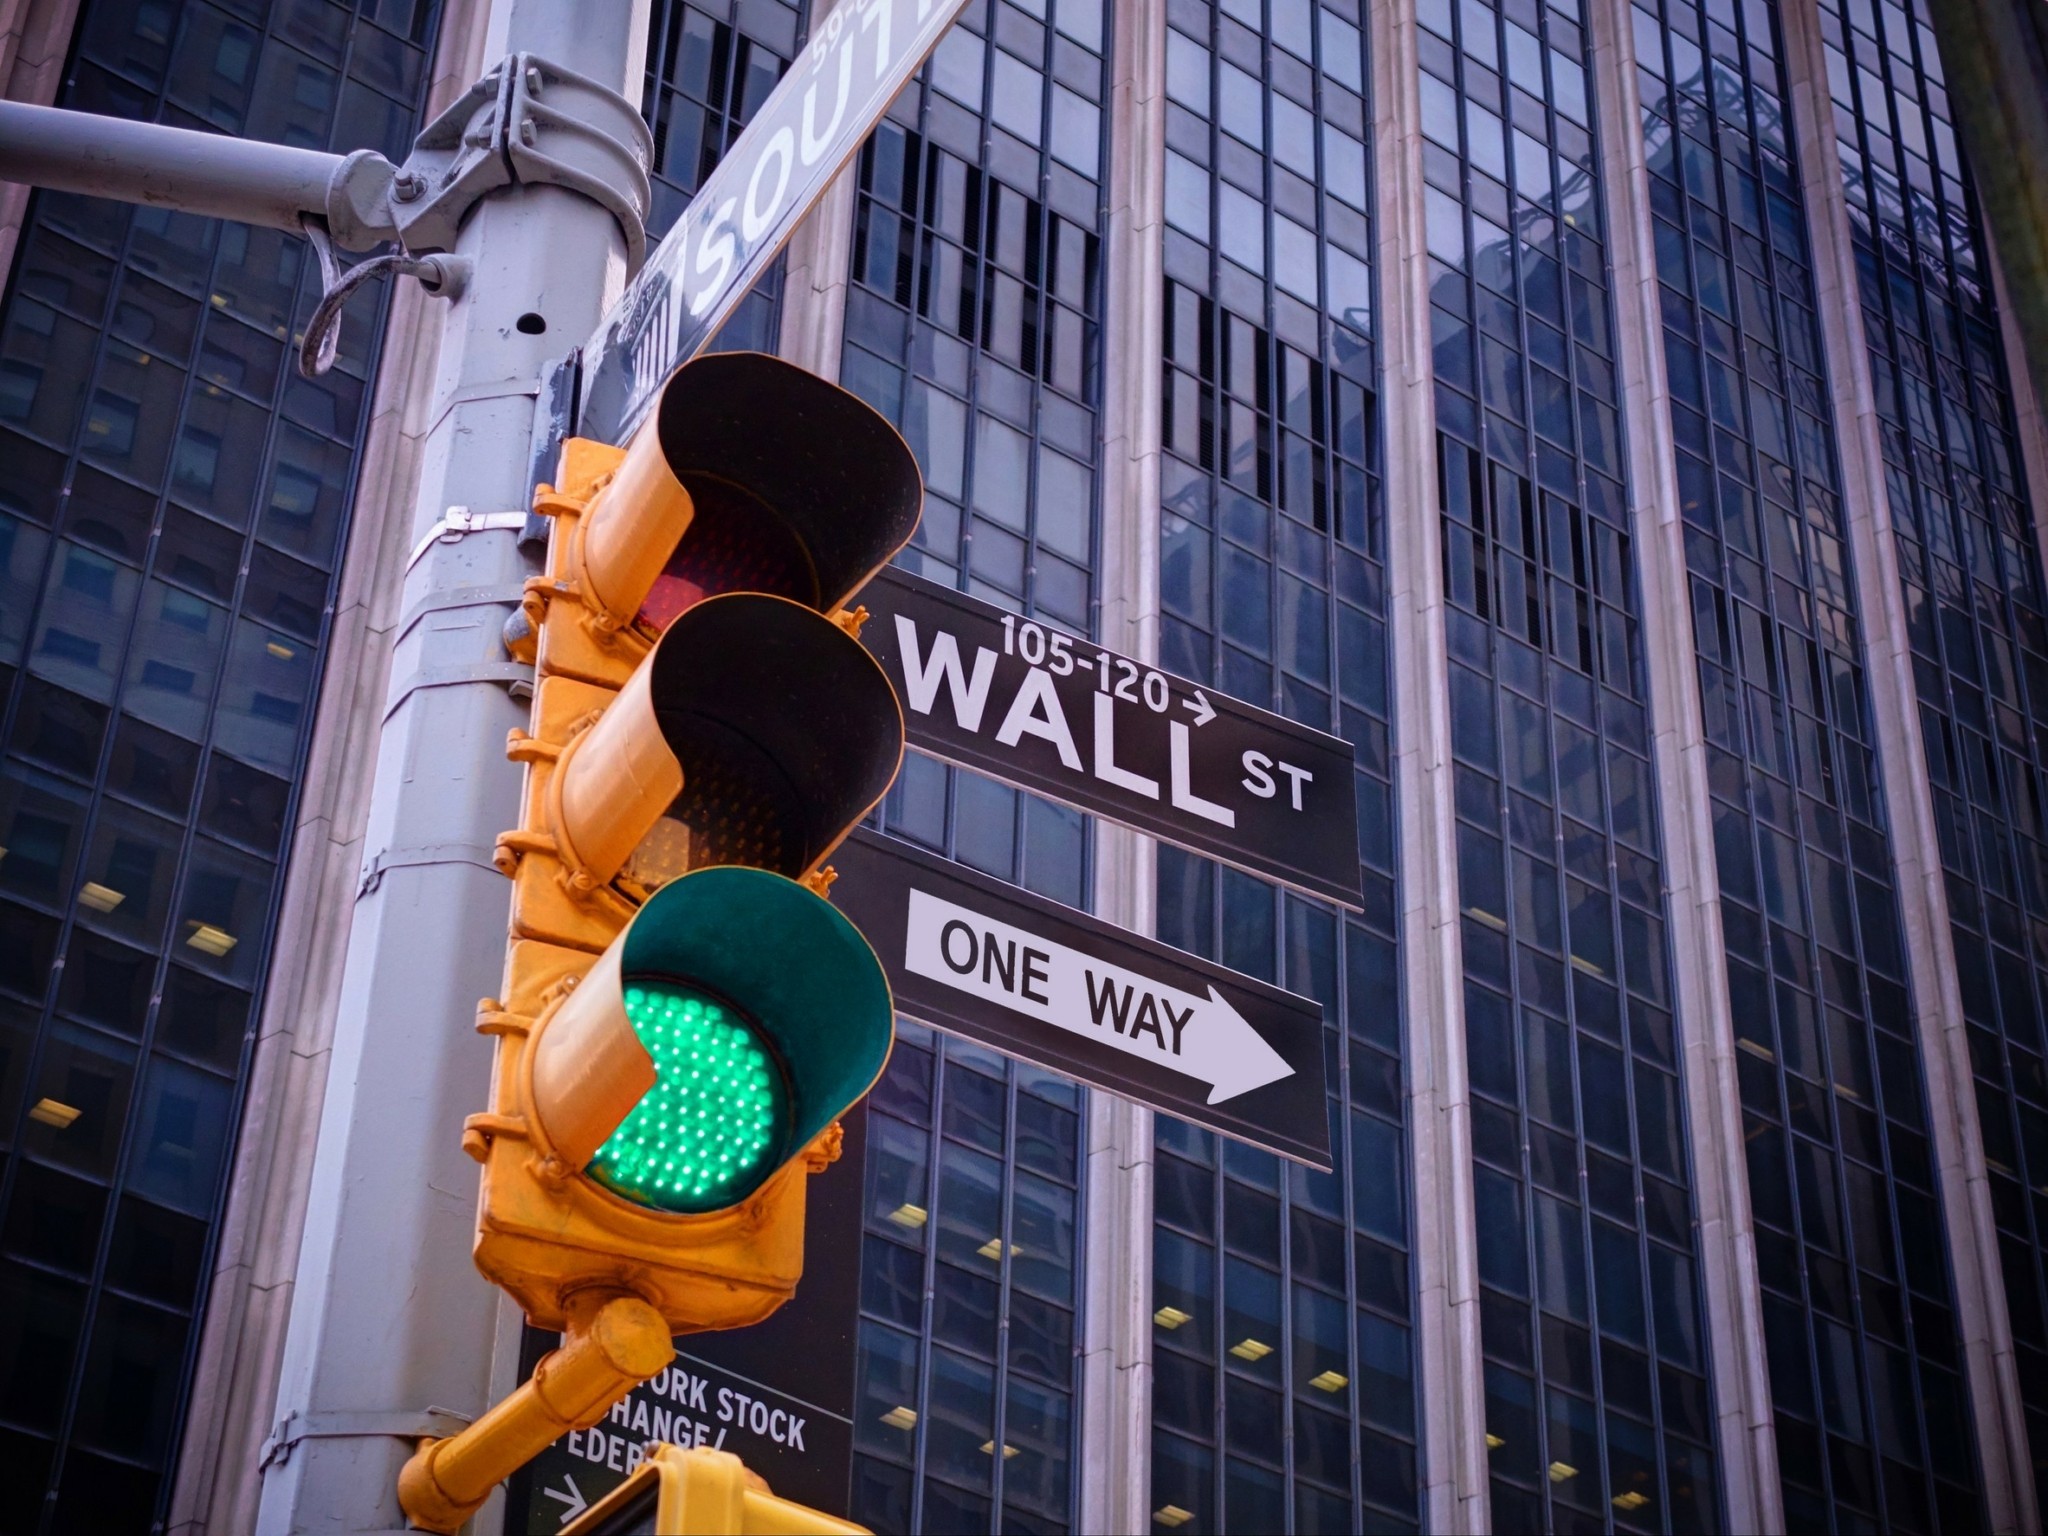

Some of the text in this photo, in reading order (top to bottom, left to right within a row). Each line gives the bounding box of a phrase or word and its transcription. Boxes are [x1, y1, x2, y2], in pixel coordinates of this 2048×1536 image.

[811, 0, 869, 76] 59-
[1000, 614, 1170, 713] 105-120
[894, 613, 1313, 829] WALL ST
[940, 919, 1194, 1056] ONE WAY
[550, 1427, 644, 1476] EDER
[603, 1393, 727, 1452] HANGE/
[637, 1366, 806, 1452] ORK STOCK
